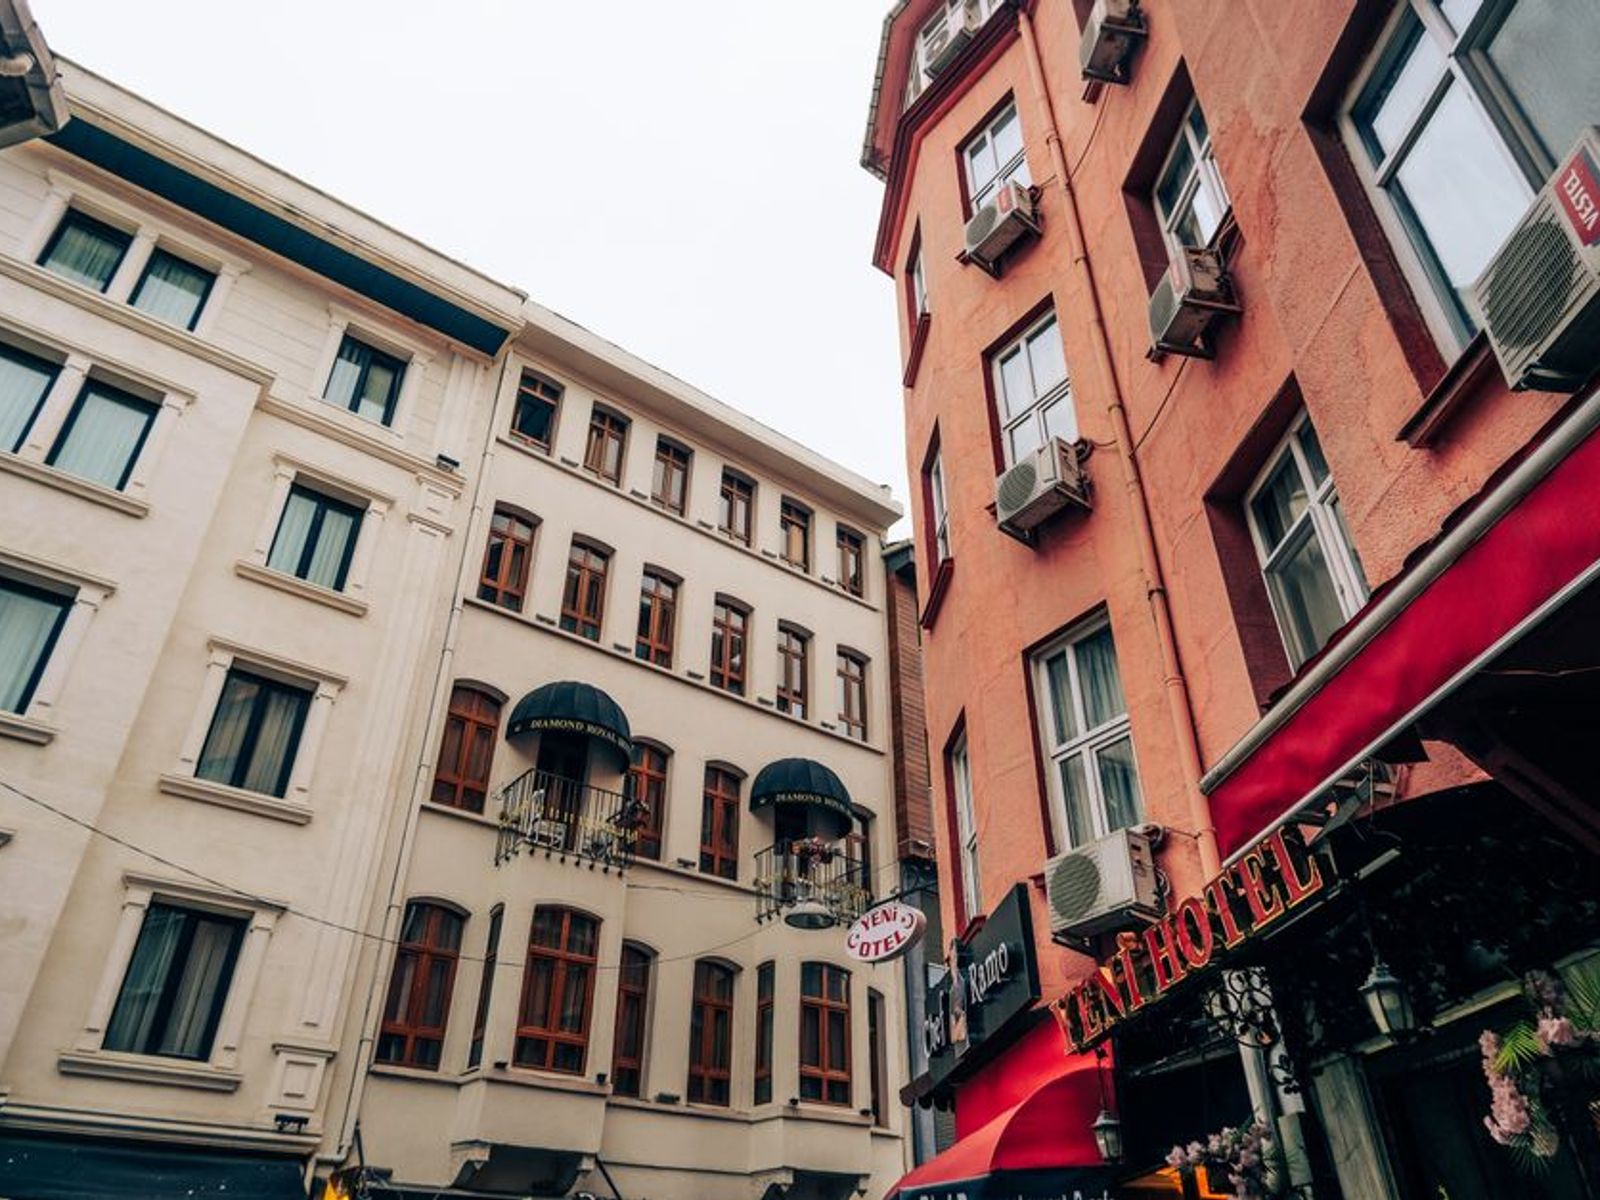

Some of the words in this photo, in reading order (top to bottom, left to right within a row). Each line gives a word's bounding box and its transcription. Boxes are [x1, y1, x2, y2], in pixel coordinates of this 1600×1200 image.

[1563, 168, 1600, 231] VESTEL
[530, 719, 584, 731] DIAMOND
[776, 793, 822, 804] DIAMOND
[1142, 823, 1324, 994] HOTEL
[858, 930, 906, 957] OTEL
